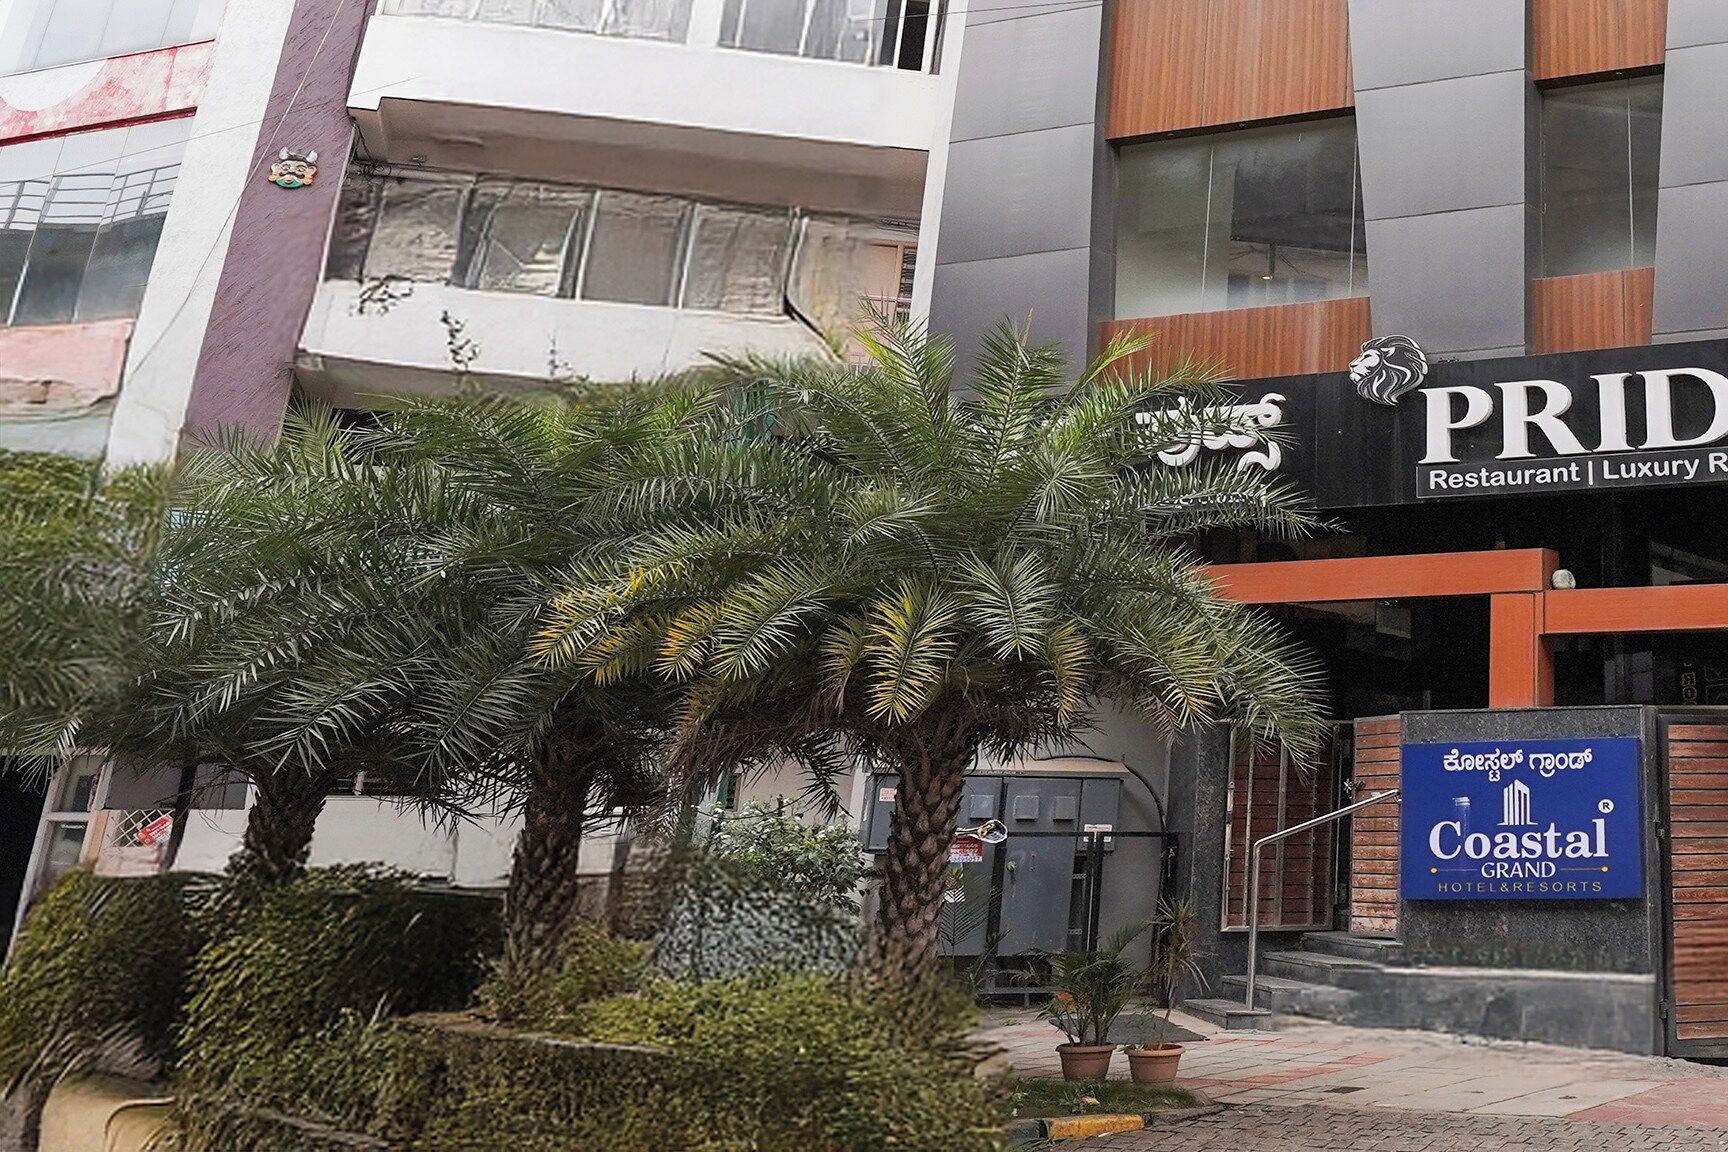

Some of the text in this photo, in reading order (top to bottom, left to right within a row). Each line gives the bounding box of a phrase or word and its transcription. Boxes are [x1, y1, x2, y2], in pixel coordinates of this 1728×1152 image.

[1429, 461, 1581, 491] Restaurant
[1602, 458, 1700, 484] Luxury
[1428, 818, 1609, 860] Coastal
[1481, 861, 1556, 879] GRAND
